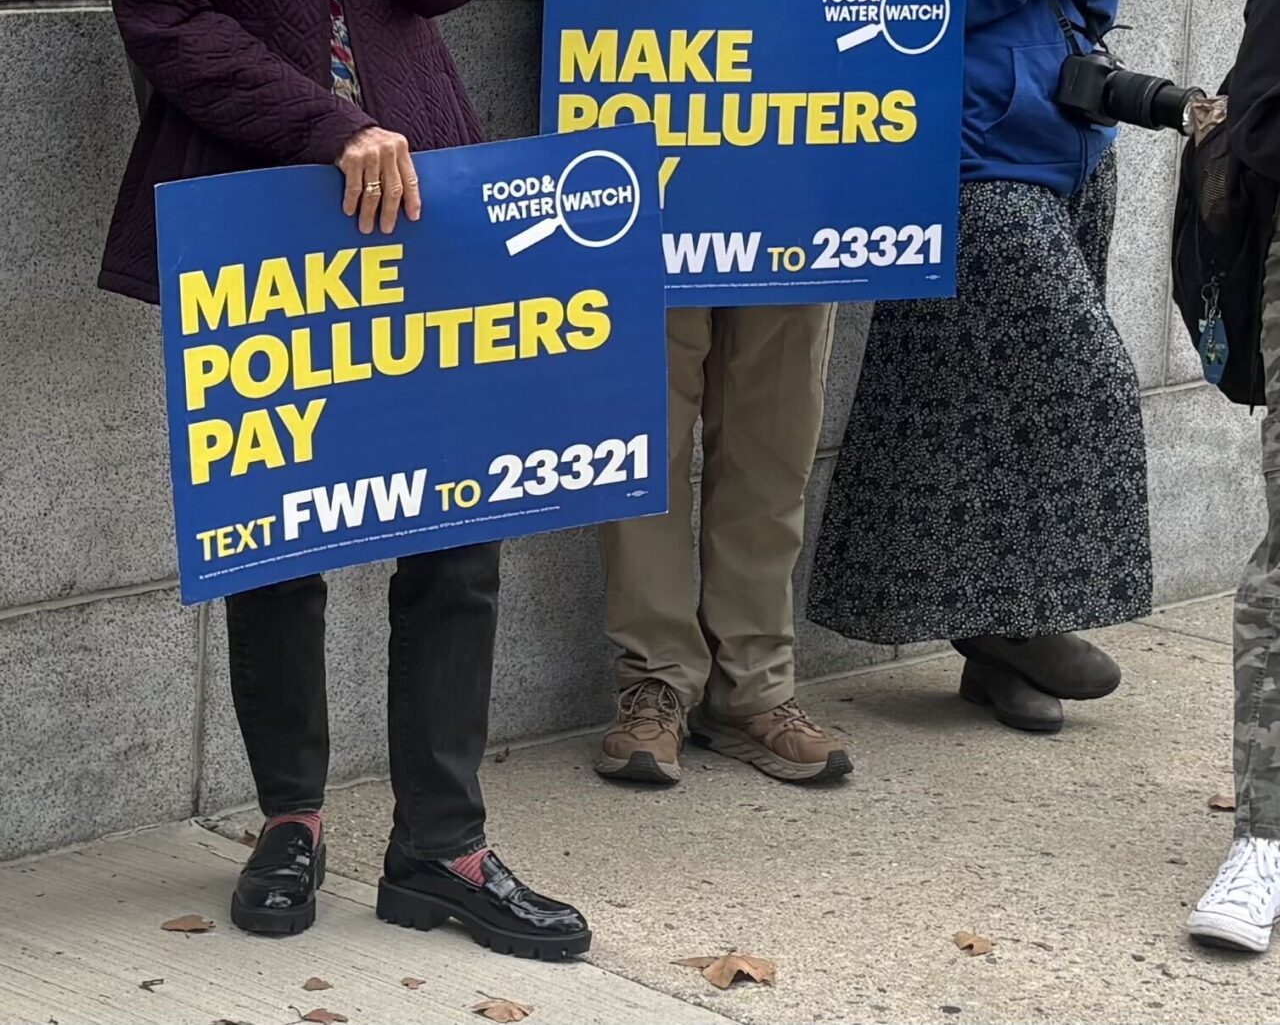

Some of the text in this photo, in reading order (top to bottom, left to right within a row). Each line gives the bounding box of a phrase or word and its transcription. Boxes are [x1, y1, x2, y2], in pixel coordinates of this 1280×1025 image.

[824, 4, 944, 22] WATER WATCH
[559, 29, 753, 83] MAKE
[558, 89, 918, 147] POLLUTERS
[482, 174, 555, 202] FOOD&
[487, 184, 633, 224] WATER WATCH
[662, 223, 943, 274] WW TO 23321
[179, 244, 404, 336] MAKE
[183, 289, 612, 411] POLLUTERS
[188, 398, 327, 485] PAY
[196, 515, 277, 562] TEXT
[282, 468, 428, 542] FWW
[434, 479, 482, 512] TO
[487, 434, 649, 503] 23321
